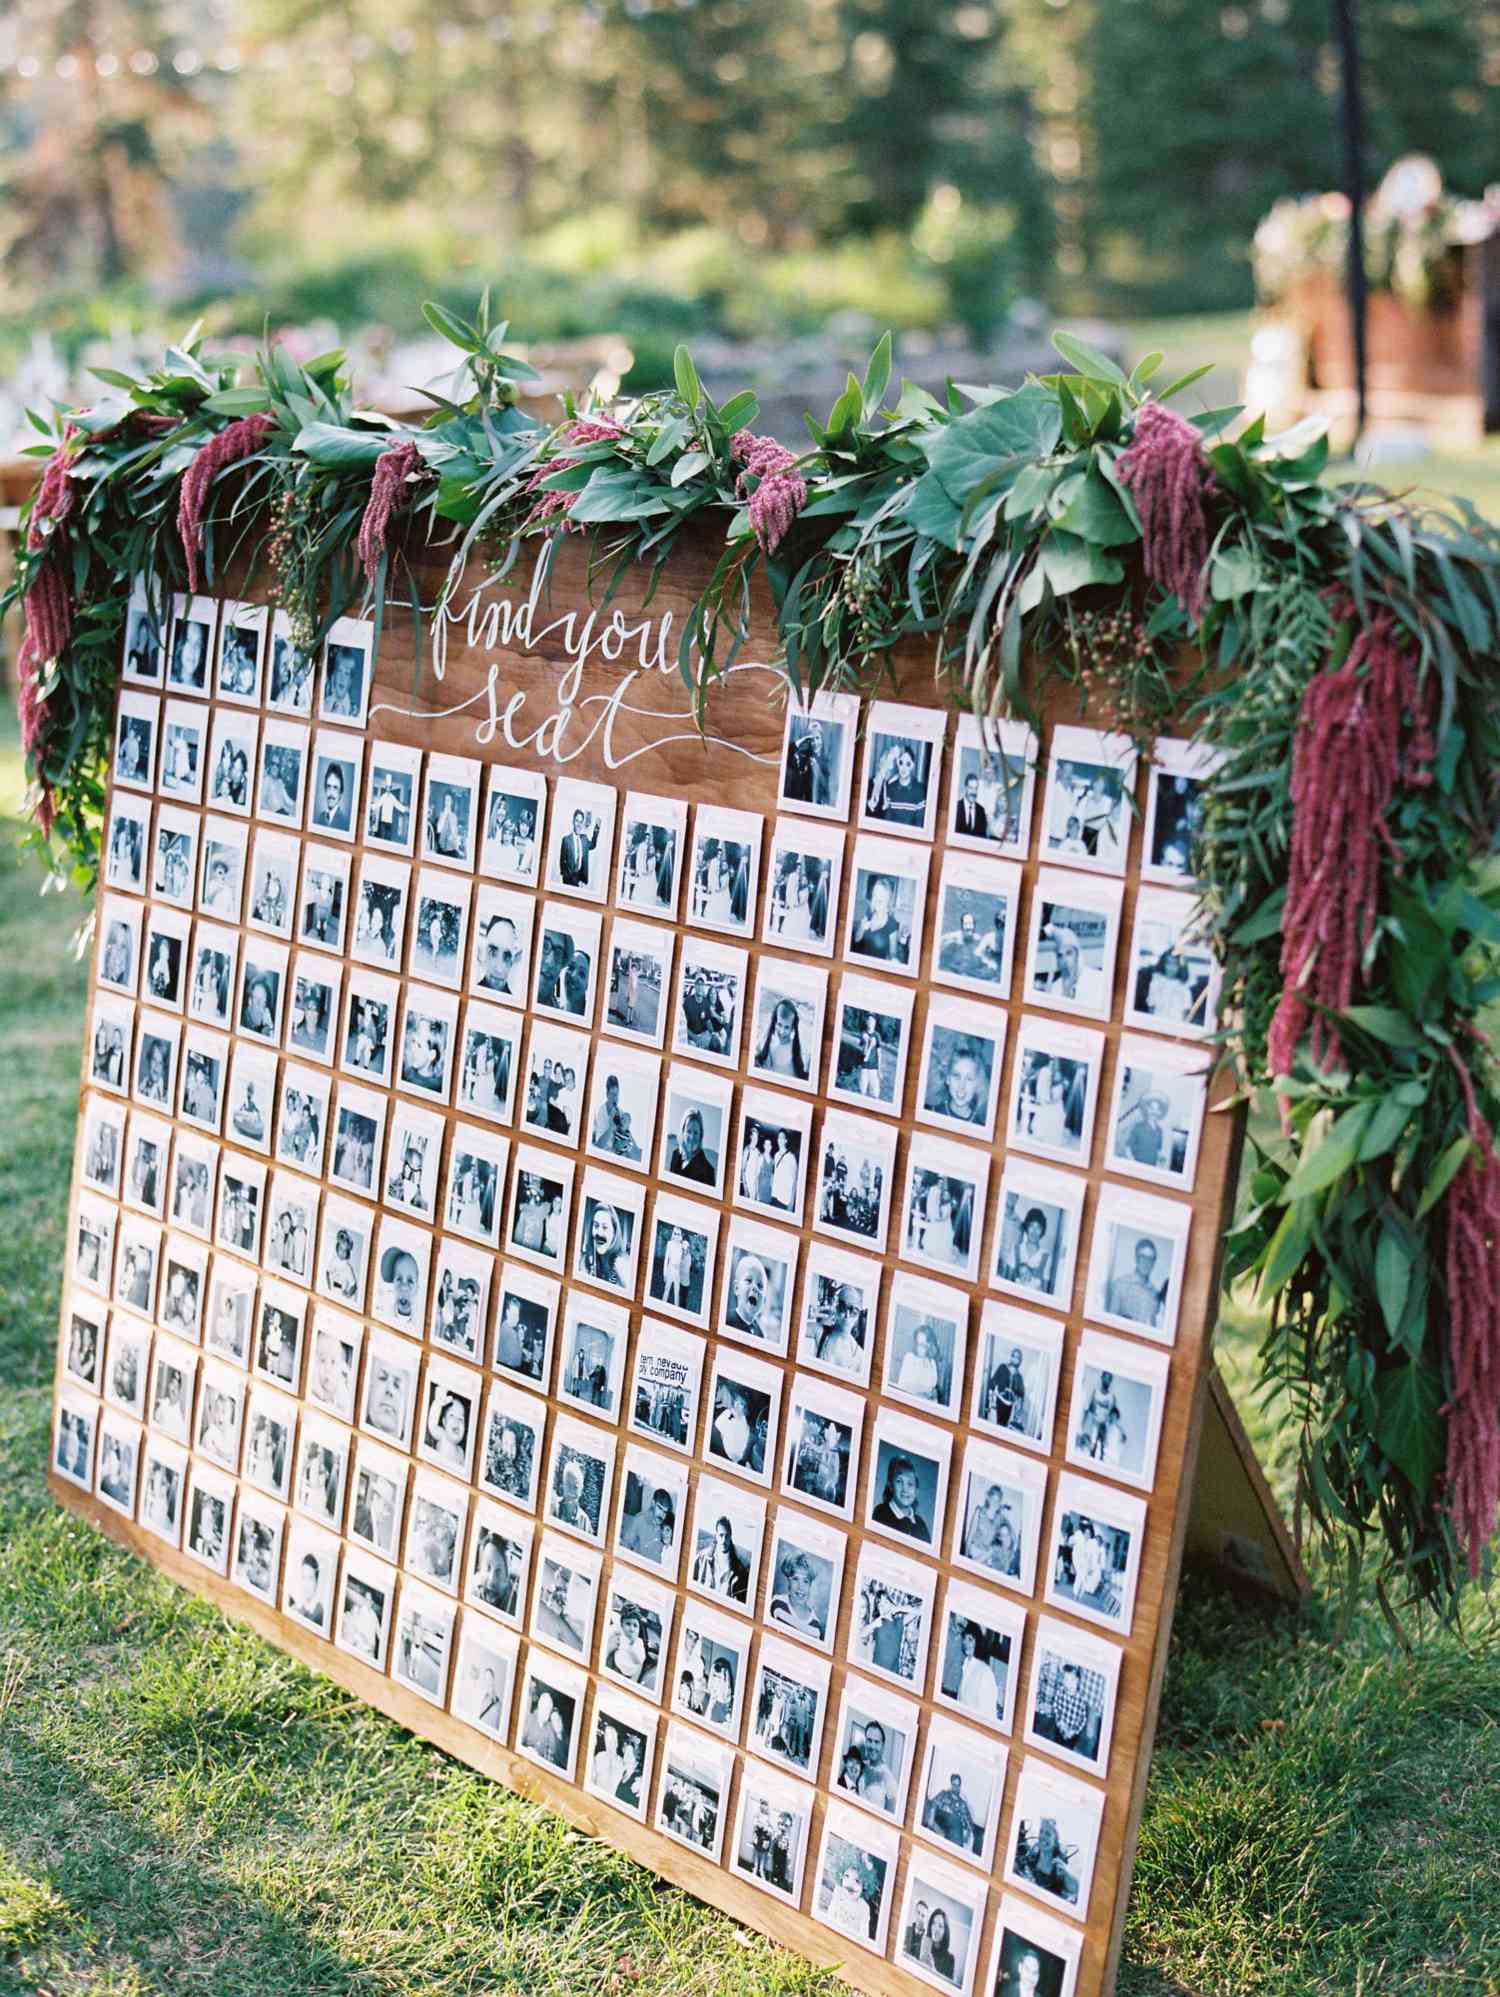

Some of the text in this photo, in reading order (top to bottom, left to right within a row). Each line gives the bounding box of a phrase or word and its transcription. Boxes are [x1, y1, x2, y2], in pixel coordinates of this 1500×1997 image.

[430, 538, 553, 681] find
[474, 663, 660, 770] seat
[650, 1366, 687, 1384] company
